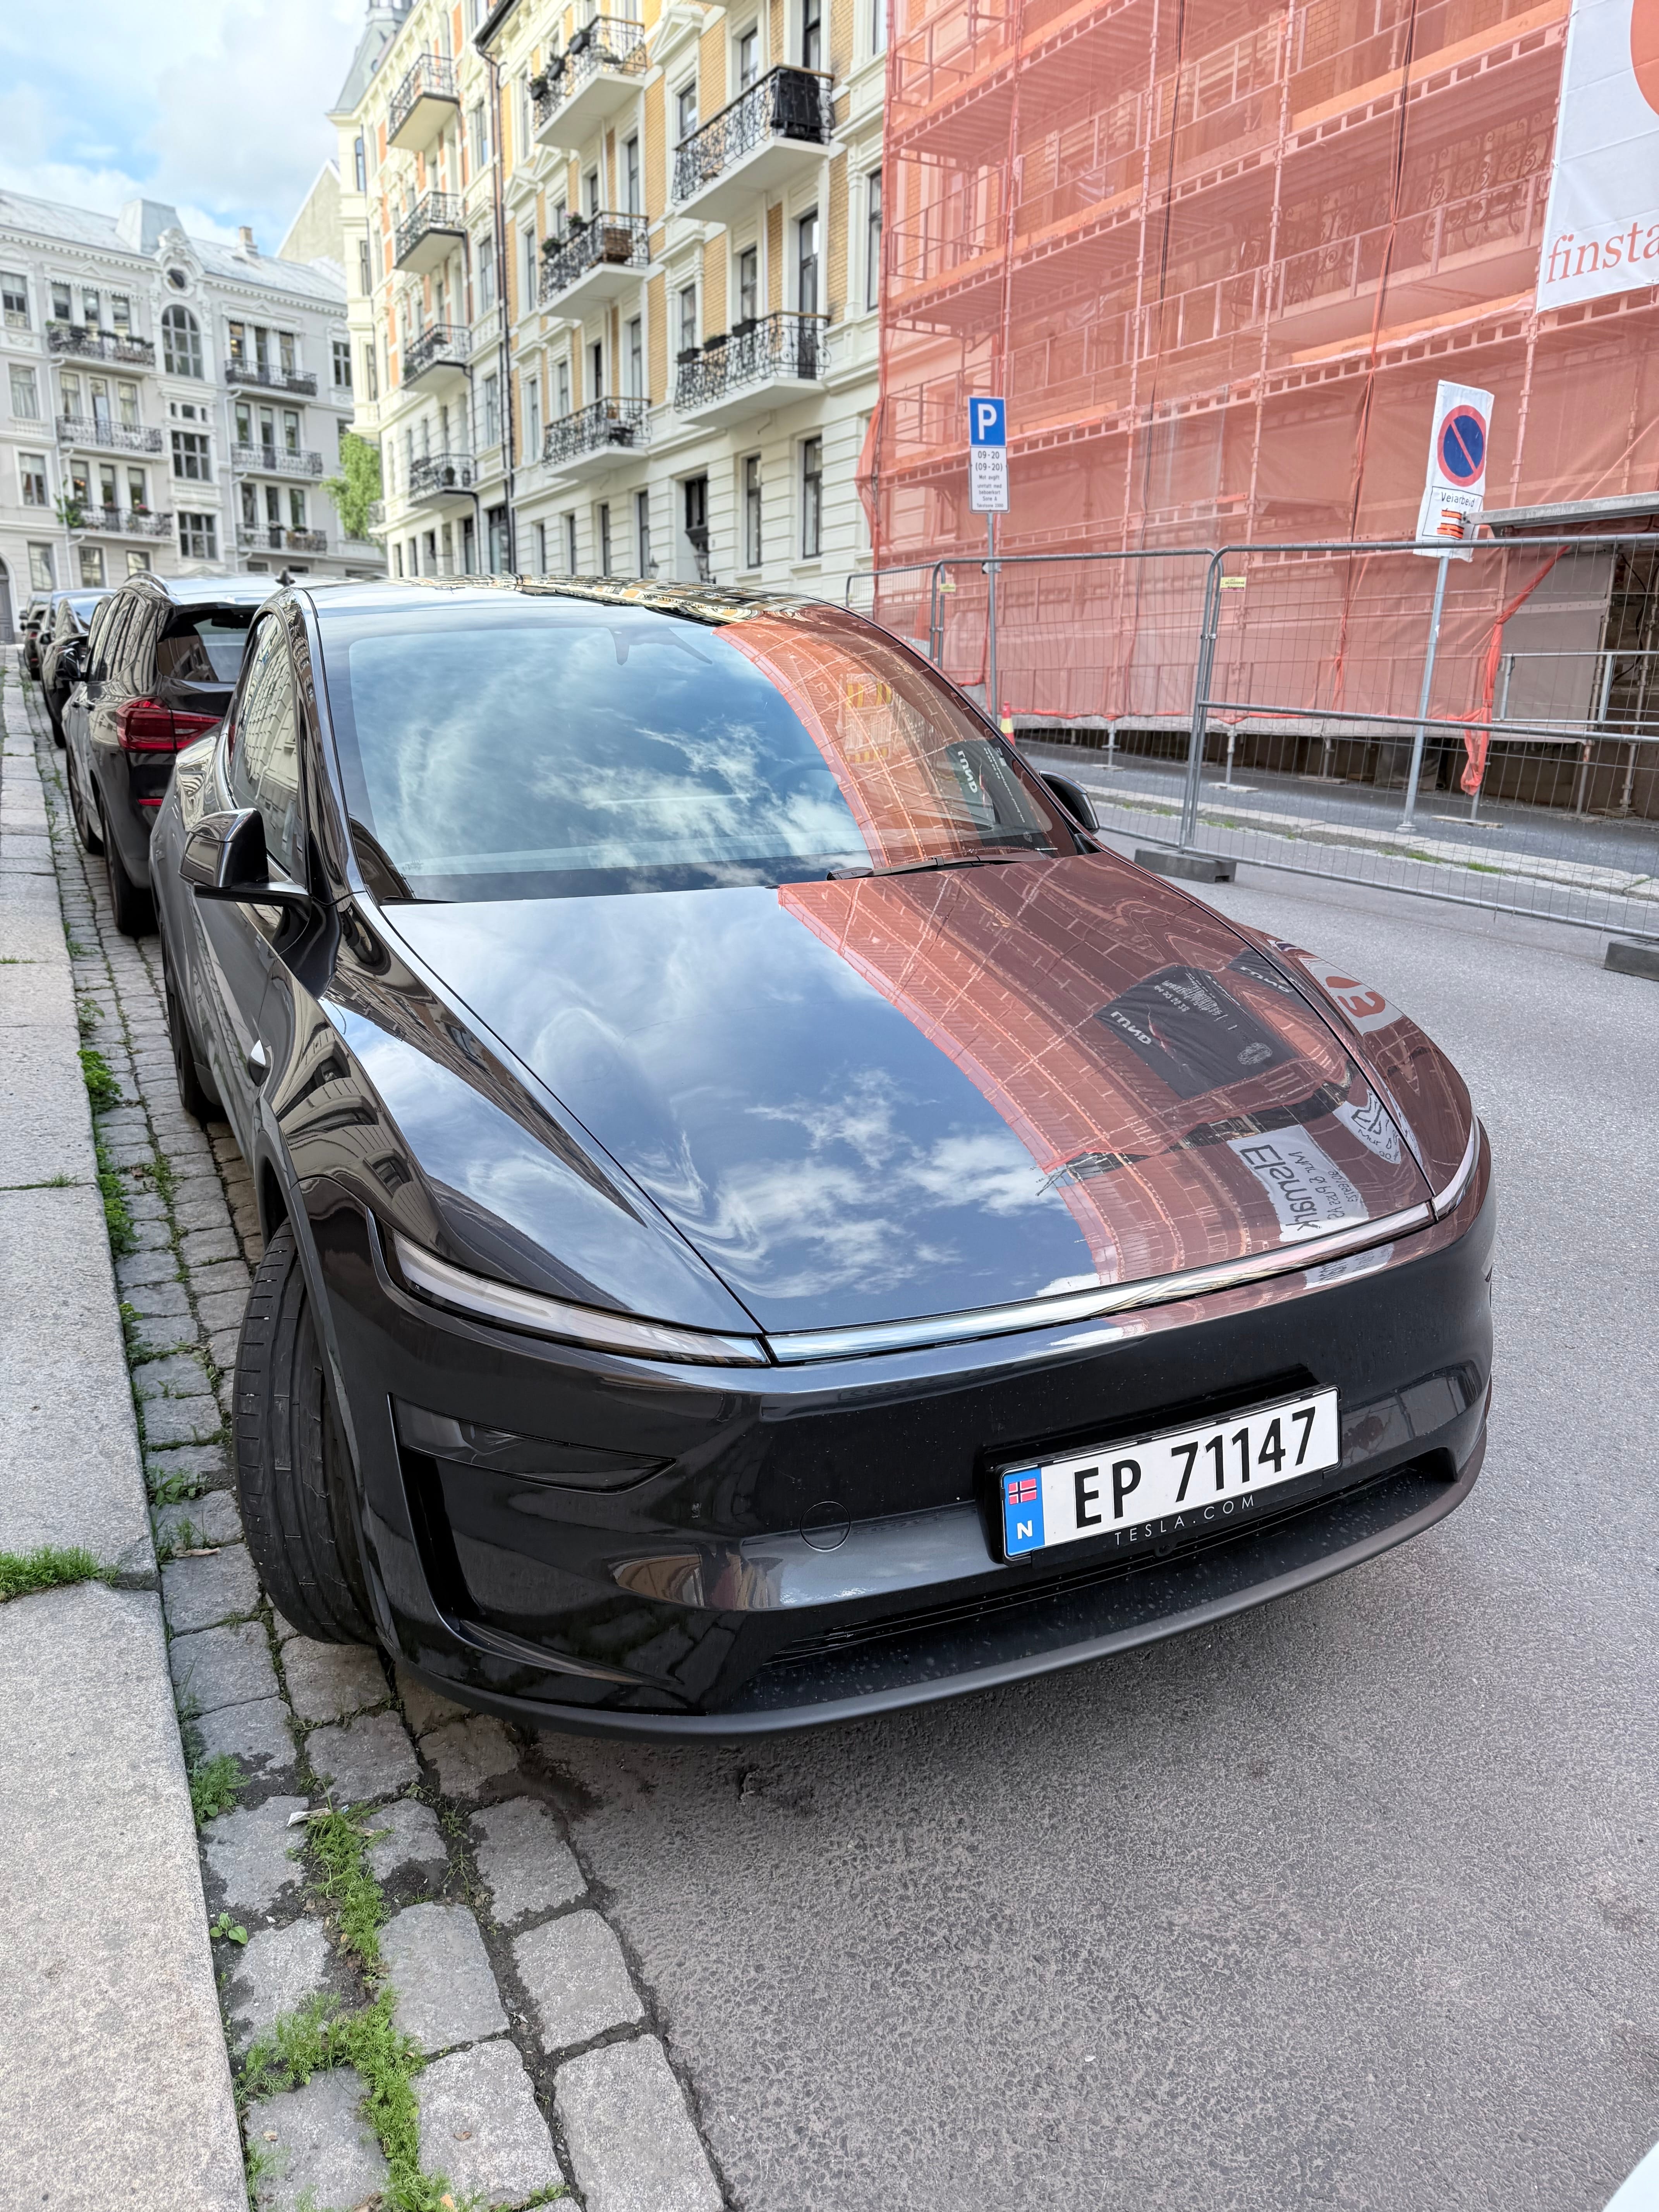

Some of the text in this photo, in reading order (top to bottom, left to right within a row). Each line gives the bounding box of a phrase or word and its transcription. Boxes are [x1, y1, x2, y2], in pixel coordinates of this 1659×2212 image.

[978, 404, 997, 440] P
[1441, 491, 1475, 507] Veiarbeid
[1017, 1406, 1316, 1540] N EP 71147
[1115, 1494, 1253, 1546] TESLA.COM
